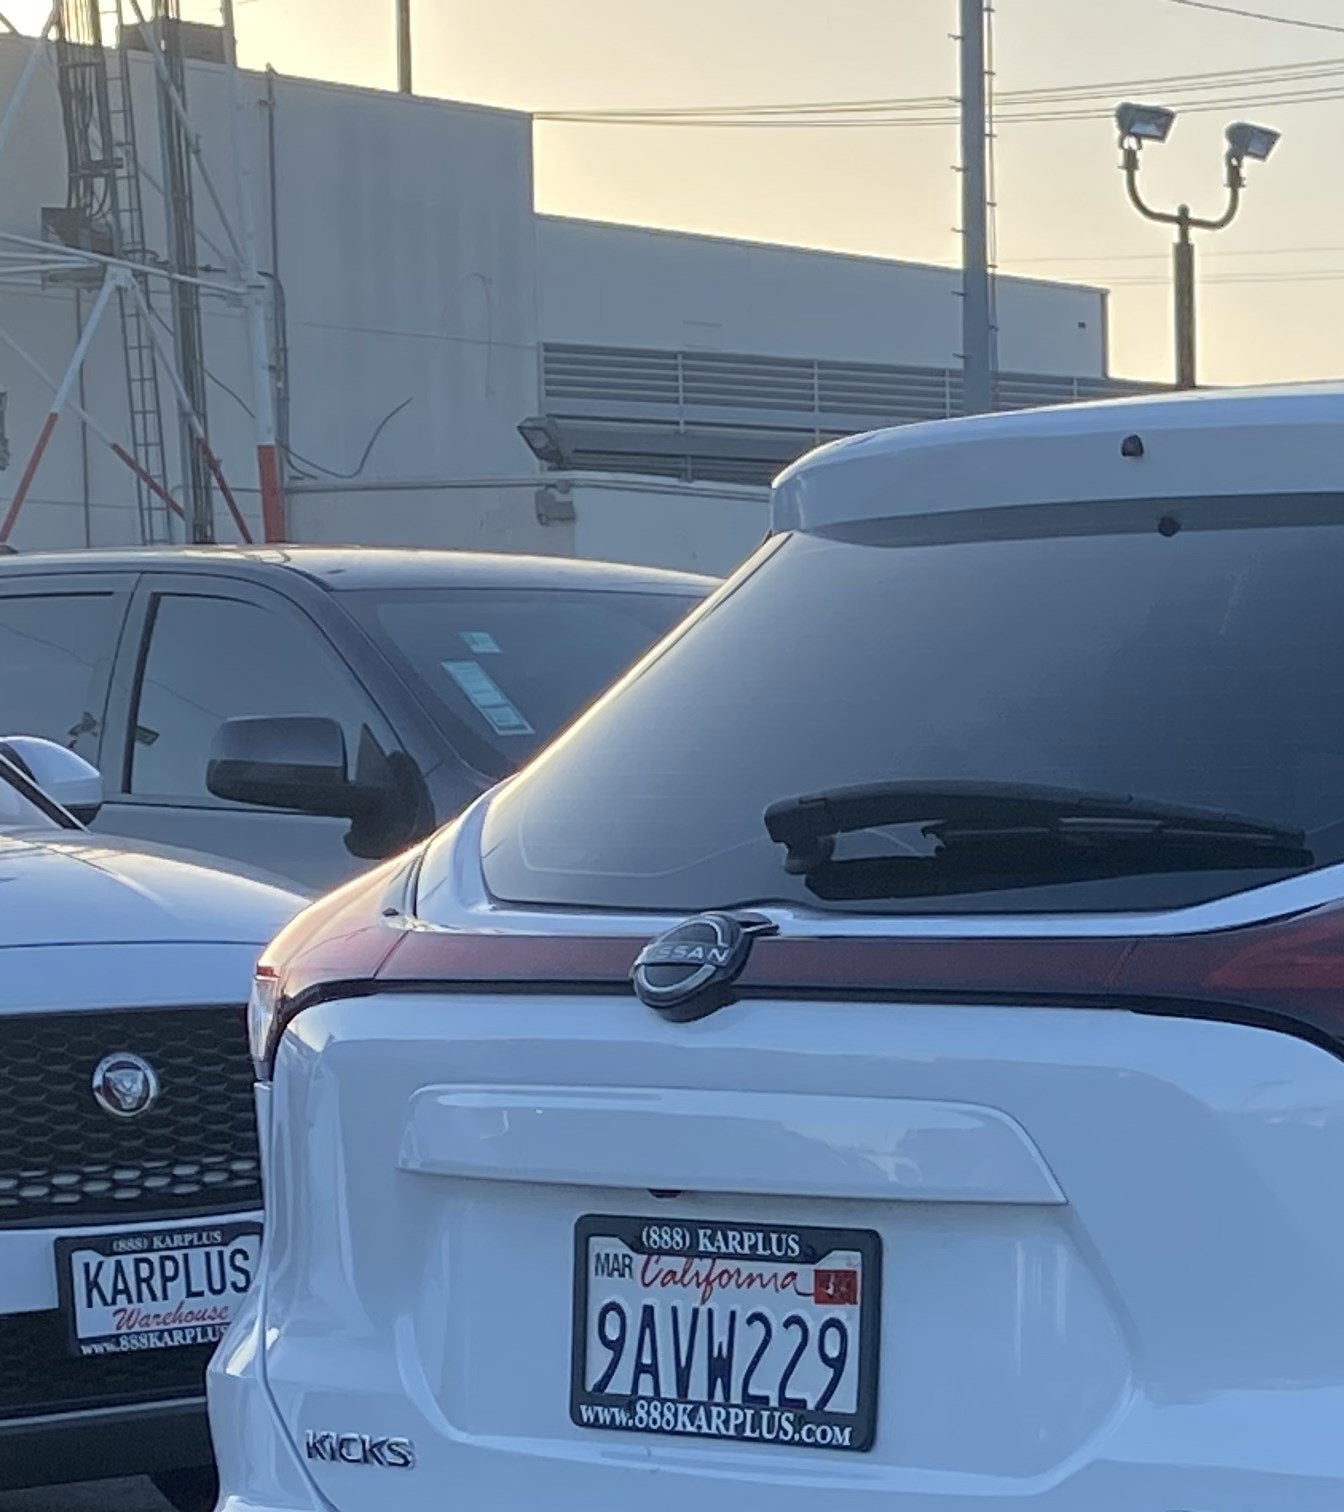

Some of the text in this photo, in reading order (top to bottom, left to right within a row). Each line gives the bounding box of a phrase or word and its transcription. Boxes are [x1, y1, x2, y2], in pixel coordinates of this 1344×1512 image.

[153, 1231, 222, 1248] KARPLUS
[642, 1226, 800, 1256] (888) KARPLUS
[84, 1248, 251, 1309] KARPLUS
[594, 1252, 633, 1280] MAR
[641, 1254, 814, 1304] California
[112, 1301, 229, 1331] Warehouse
[592, 1300, 849, 1412] 9AVW229
[306, 1429, 414, 1468] KICKS
